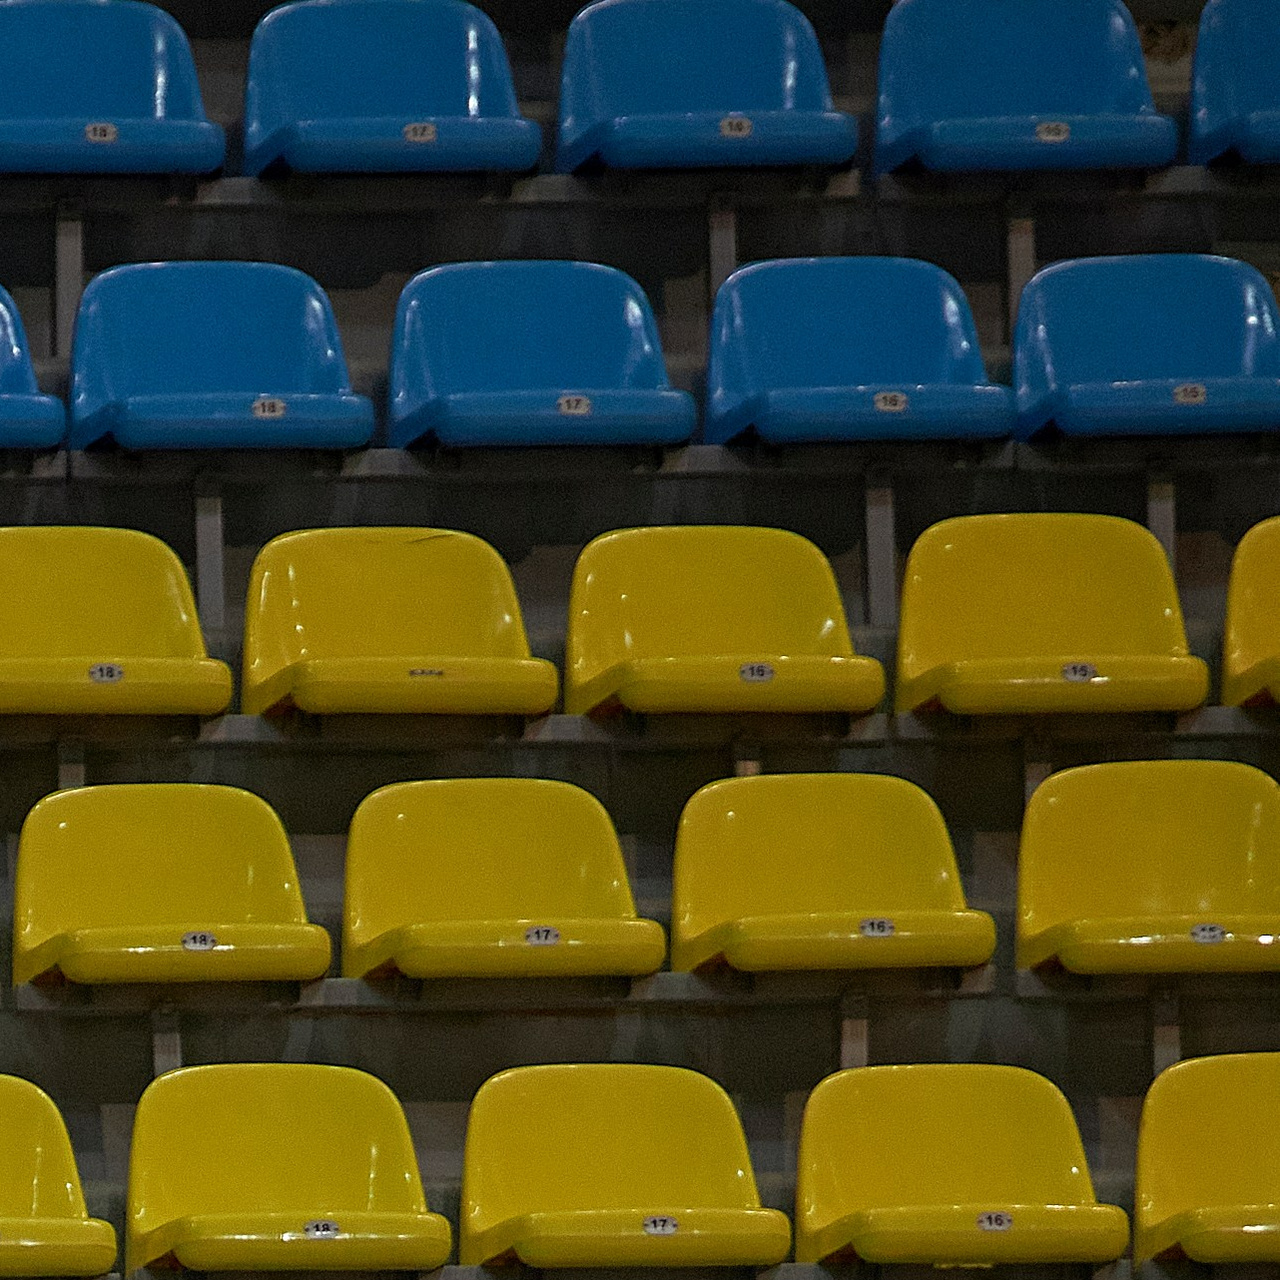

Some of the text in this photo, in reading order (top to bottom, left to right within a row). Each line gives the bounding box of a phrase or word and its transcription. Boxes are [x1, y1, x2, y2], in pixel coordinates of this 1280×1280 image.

[98, 667, 113, 677] 18
[870, 922, 885, 932] 16
[191, 935, 206, 945] 18
[535, 930, 550, 940] 17
[652, 1219, 667, 1229] 17
[987, 1215, 1002, 1225] 16
